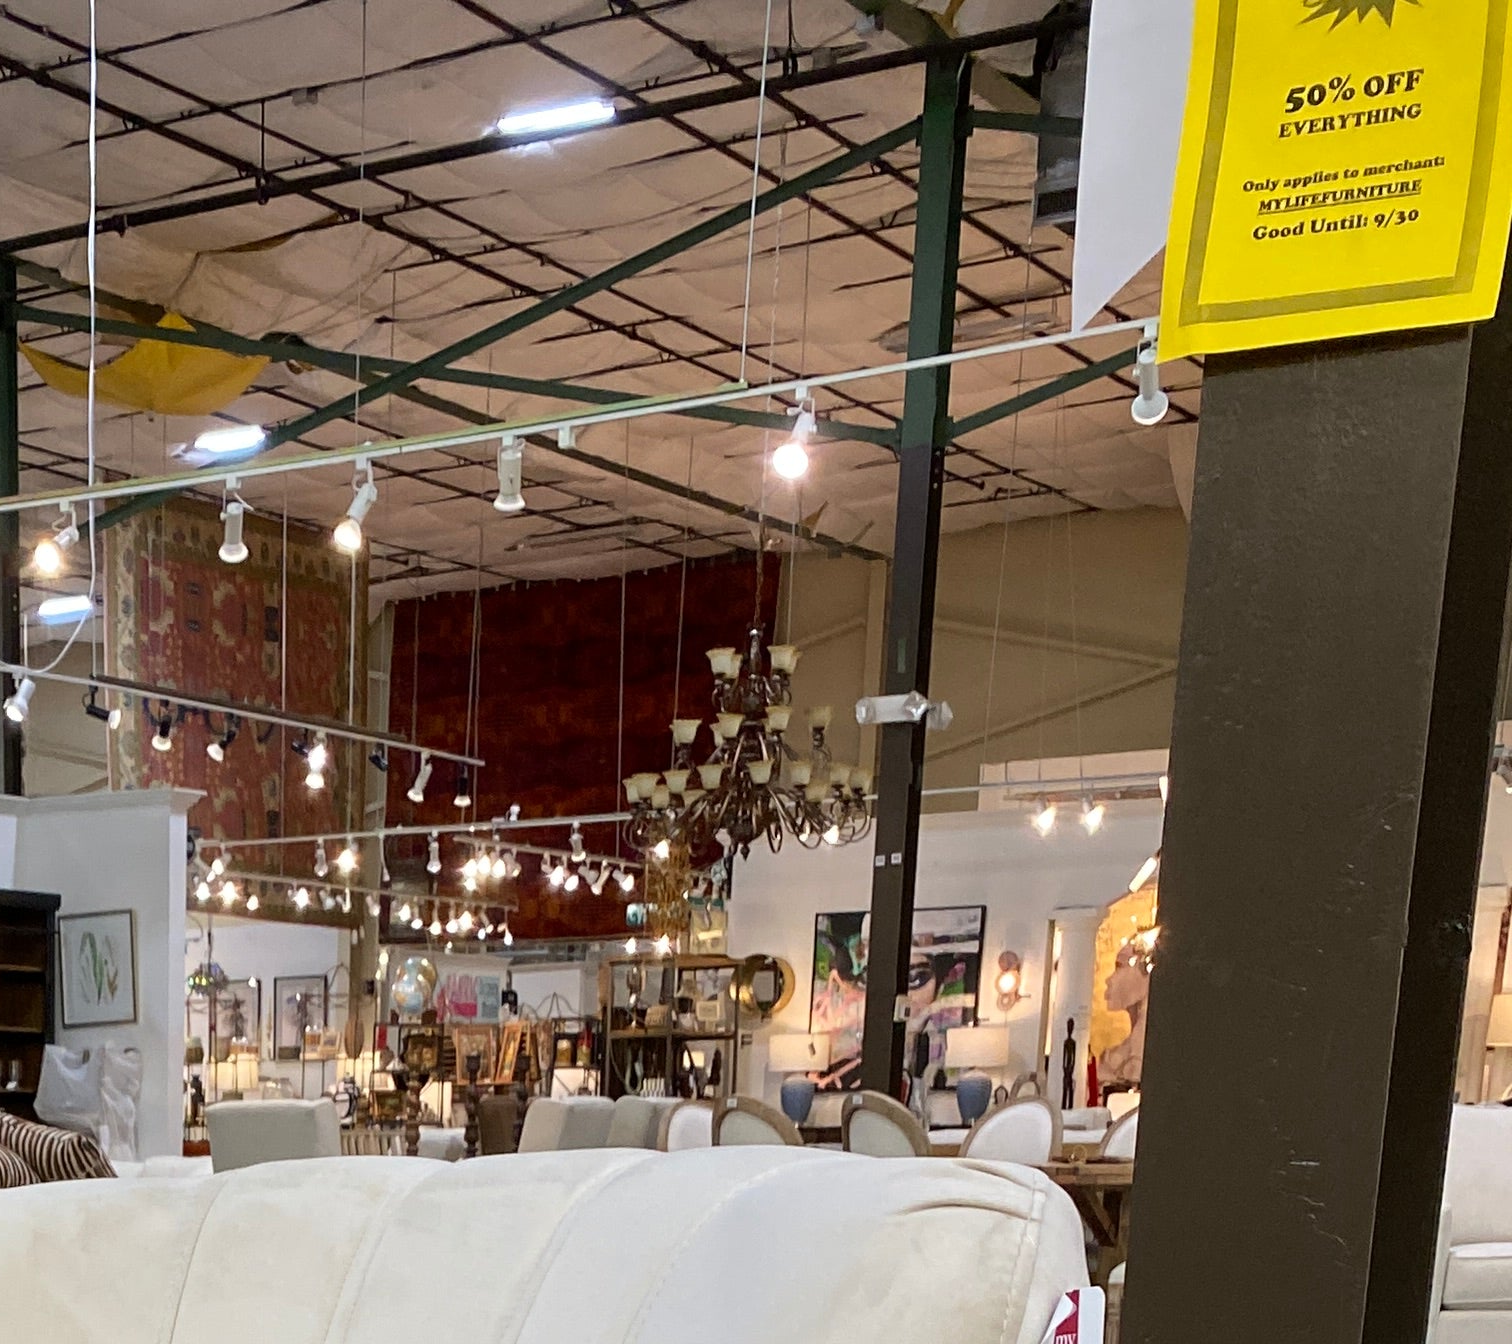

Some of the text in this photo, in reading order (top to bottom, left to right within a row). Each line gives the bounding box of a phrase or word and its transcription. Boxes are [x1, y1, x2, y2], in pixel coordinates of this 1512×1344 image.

[1285, 68, 1425, 113] 50% OFF
[1279, 103, 1422, 138] EVERYTHING
[1242, 156, 1445, 193] Only applies to merchant:
[1258, 179, 1422, 214] MYLIFEFURNITURE
[1252, 209, 1419, 240] Good Until: 9/30
